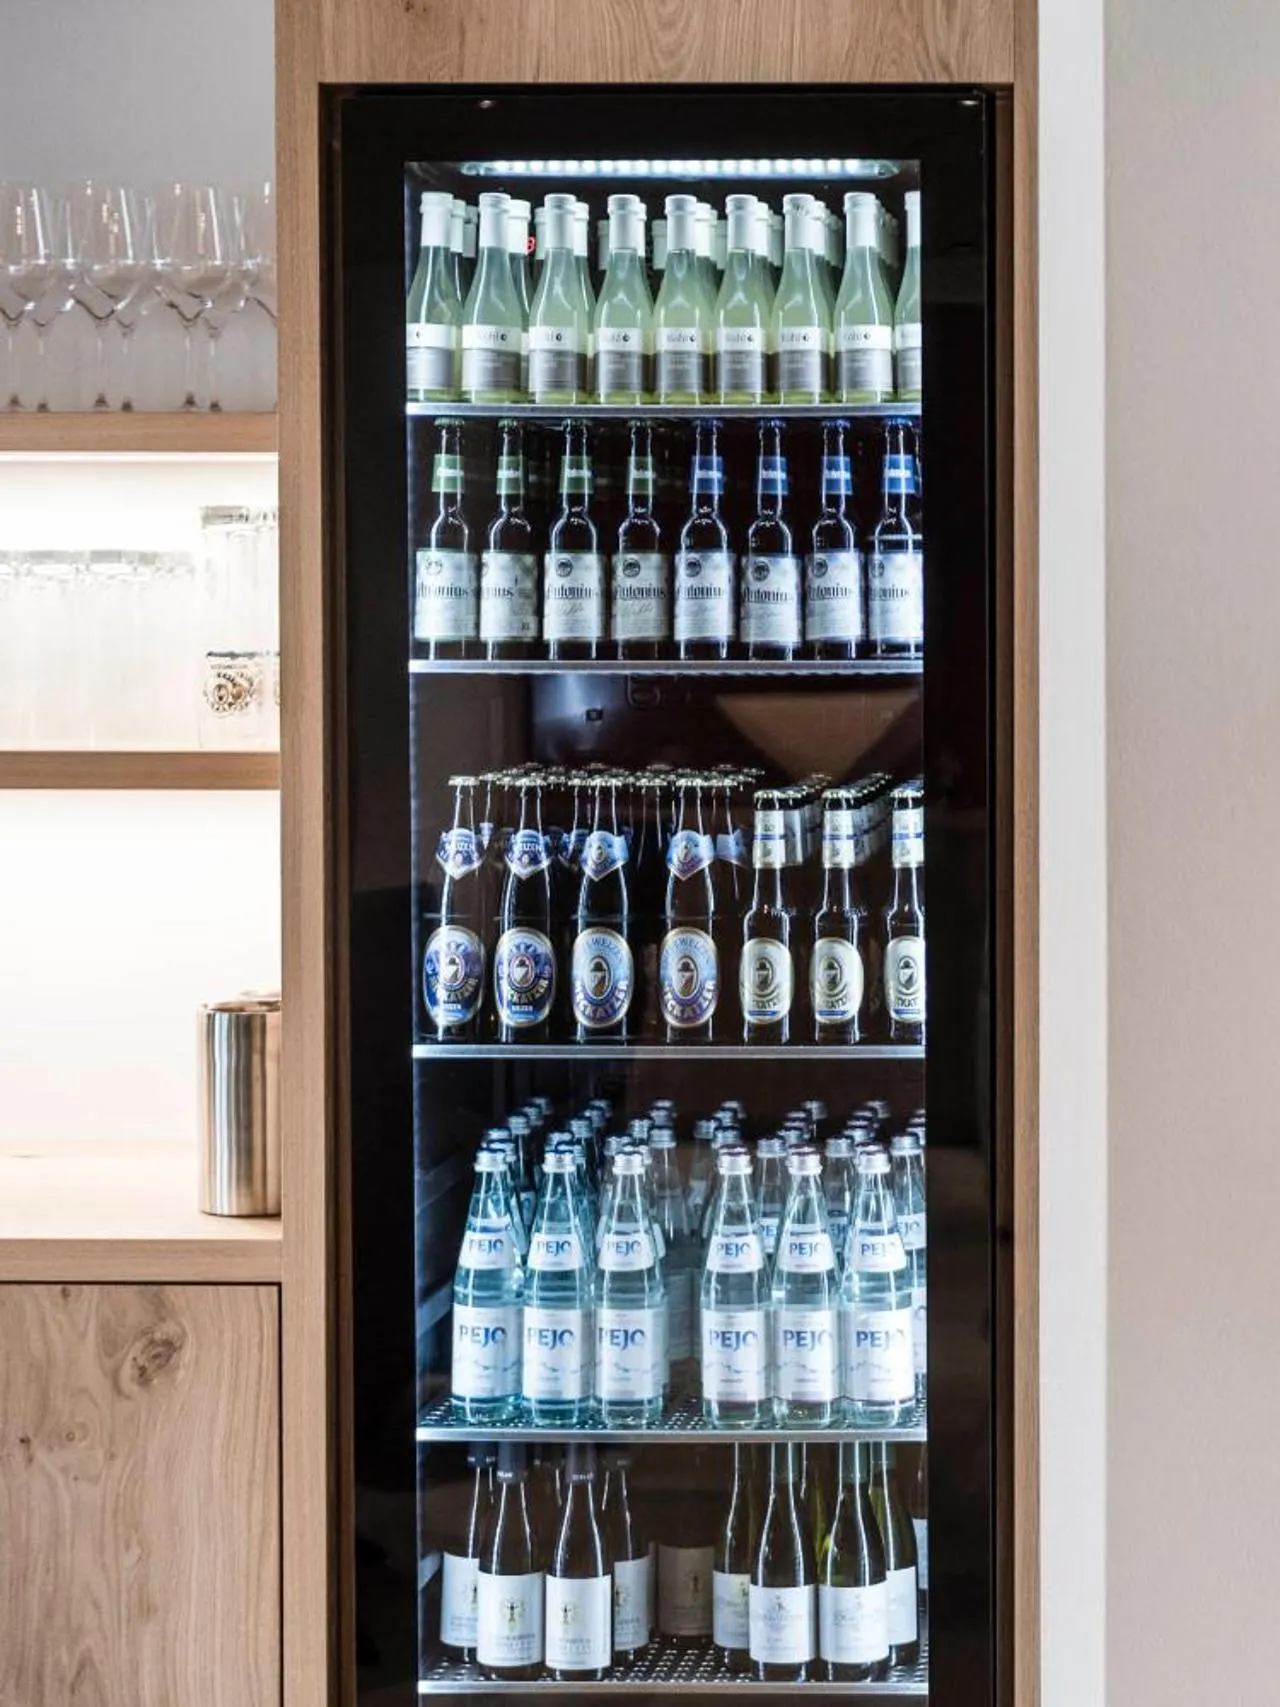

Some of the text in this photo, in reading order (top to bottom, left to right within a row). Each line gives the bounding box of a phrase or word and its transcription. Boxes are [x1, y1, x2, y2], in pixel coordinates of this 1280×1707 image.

[469, 1239, 504, 1256] PEJO
[537, 1240, 572, 1256] PEJO
[607, 1239, 642, 1256] PEJO
[716, 1242, 750, 1258] PEJO
[459, 1325, 507, 1348] PEJO
[528, 1327, 574, 1350] PEJO
[598, 1327, 645, 1350] PEJO
[709, 1330, 758, 1352] PEJO
[783, 1329, 831, 1352] PEJO
